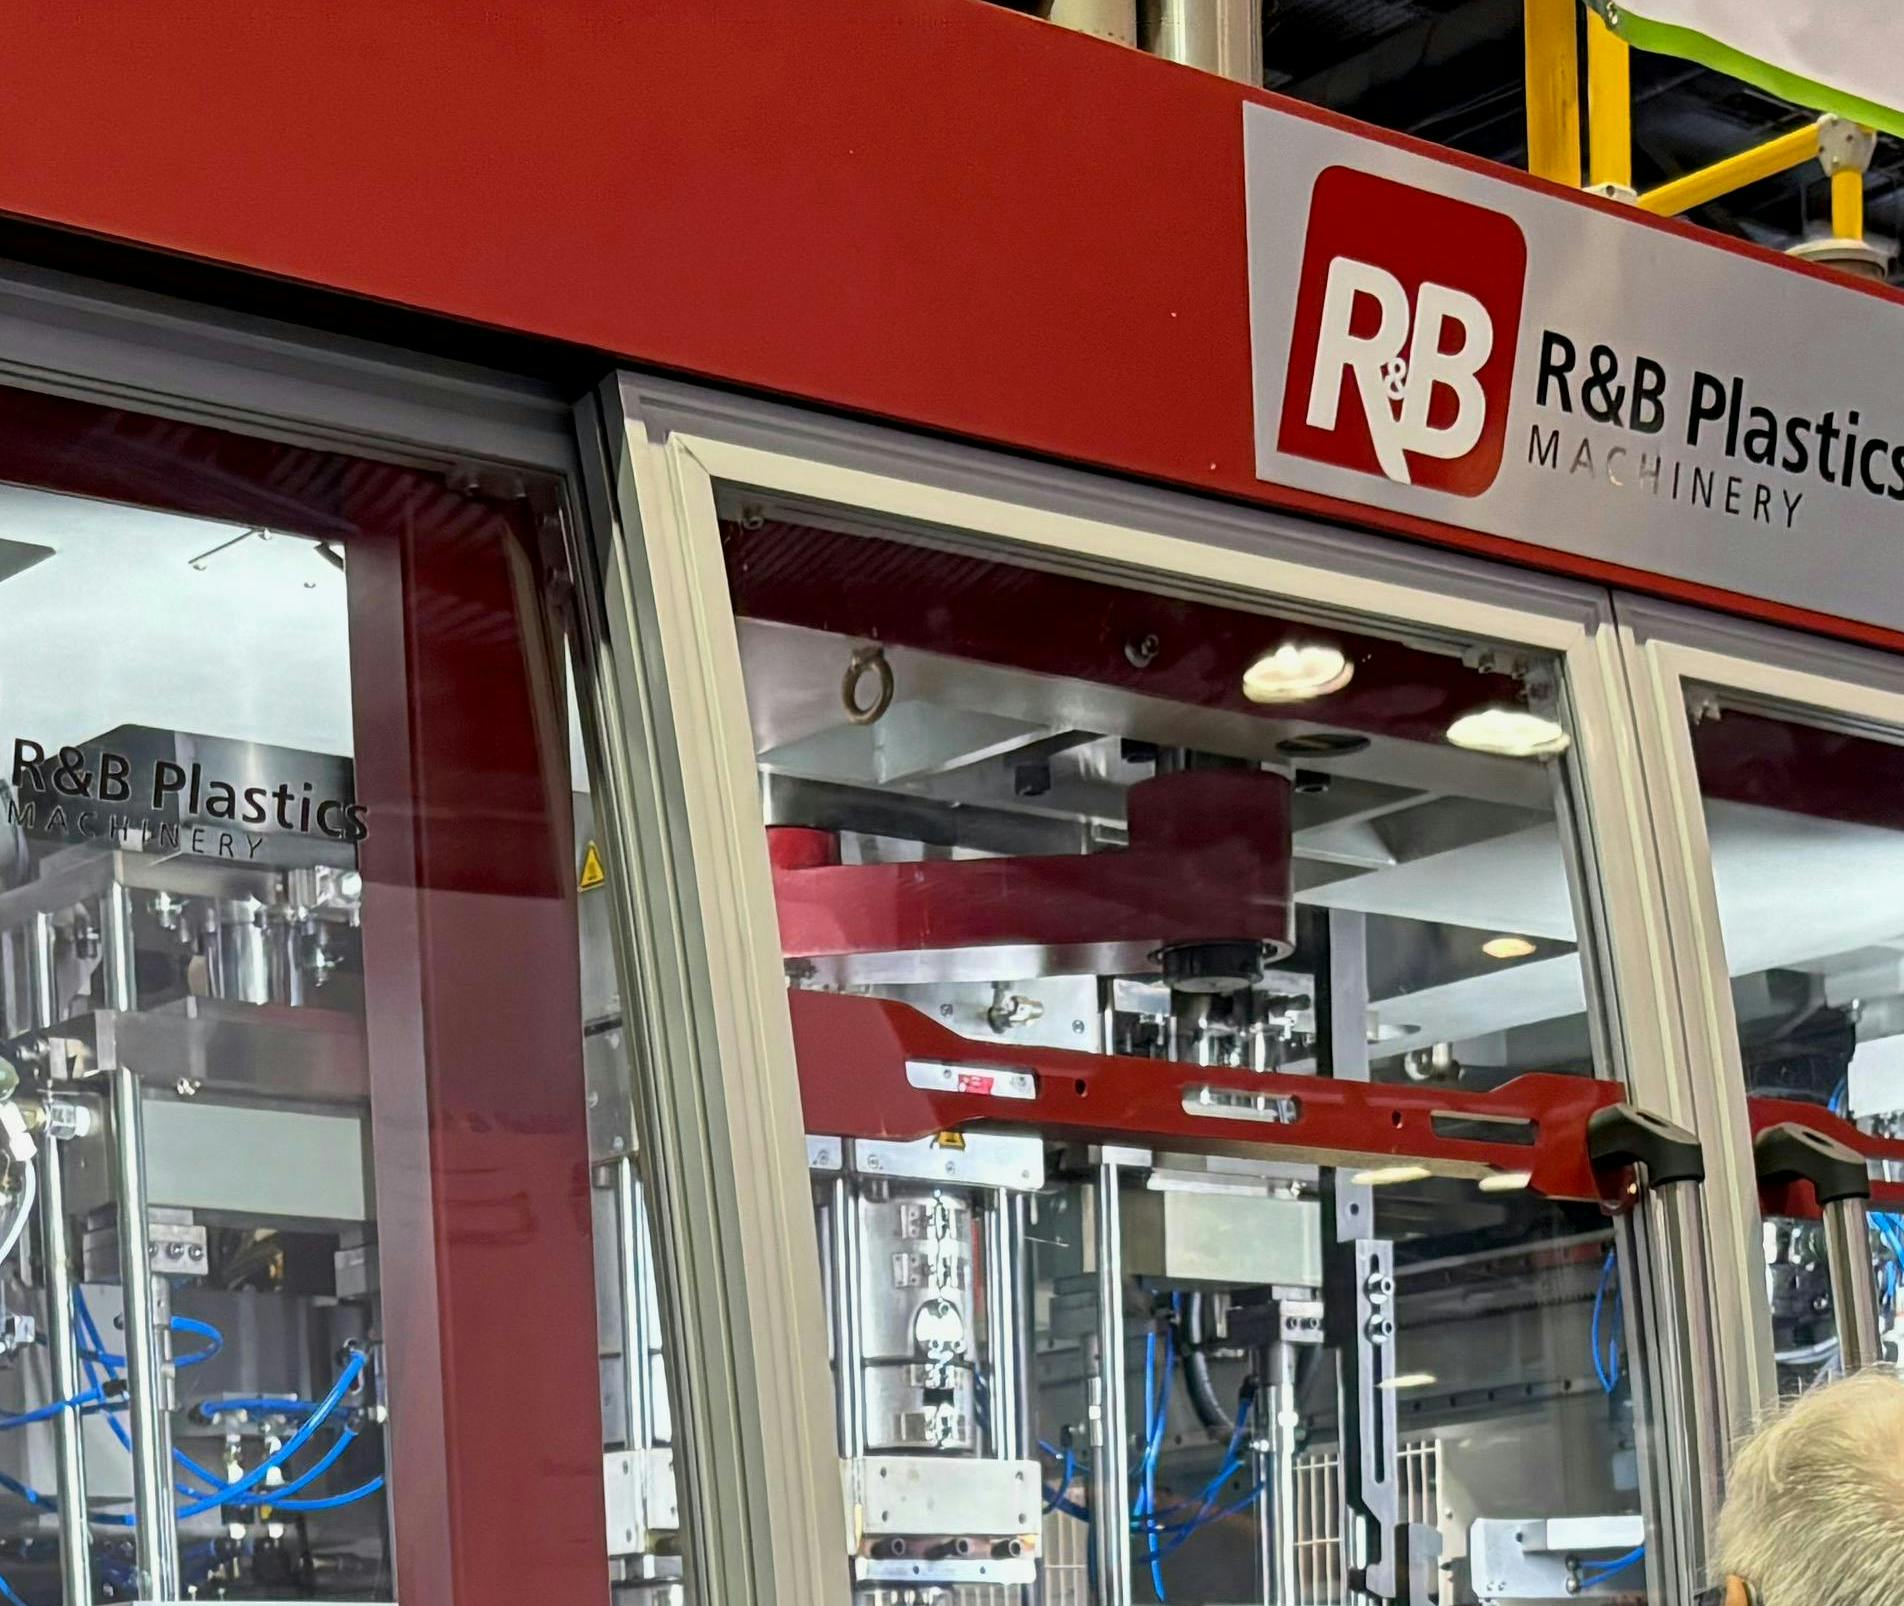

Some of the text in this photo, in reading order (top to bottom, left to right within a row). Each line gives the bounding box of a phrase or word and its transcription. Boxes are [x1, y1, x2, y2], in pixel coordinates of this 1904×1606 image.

[1305, 256, 1494, 486] R&B
[1535, 330, 1666, 435] R&B
[1527, 424, 1804, 529] MACHINERY
[4, 798, 266, 861] MACHINERY
[11, 737, 370, 843] R&B Plastics
